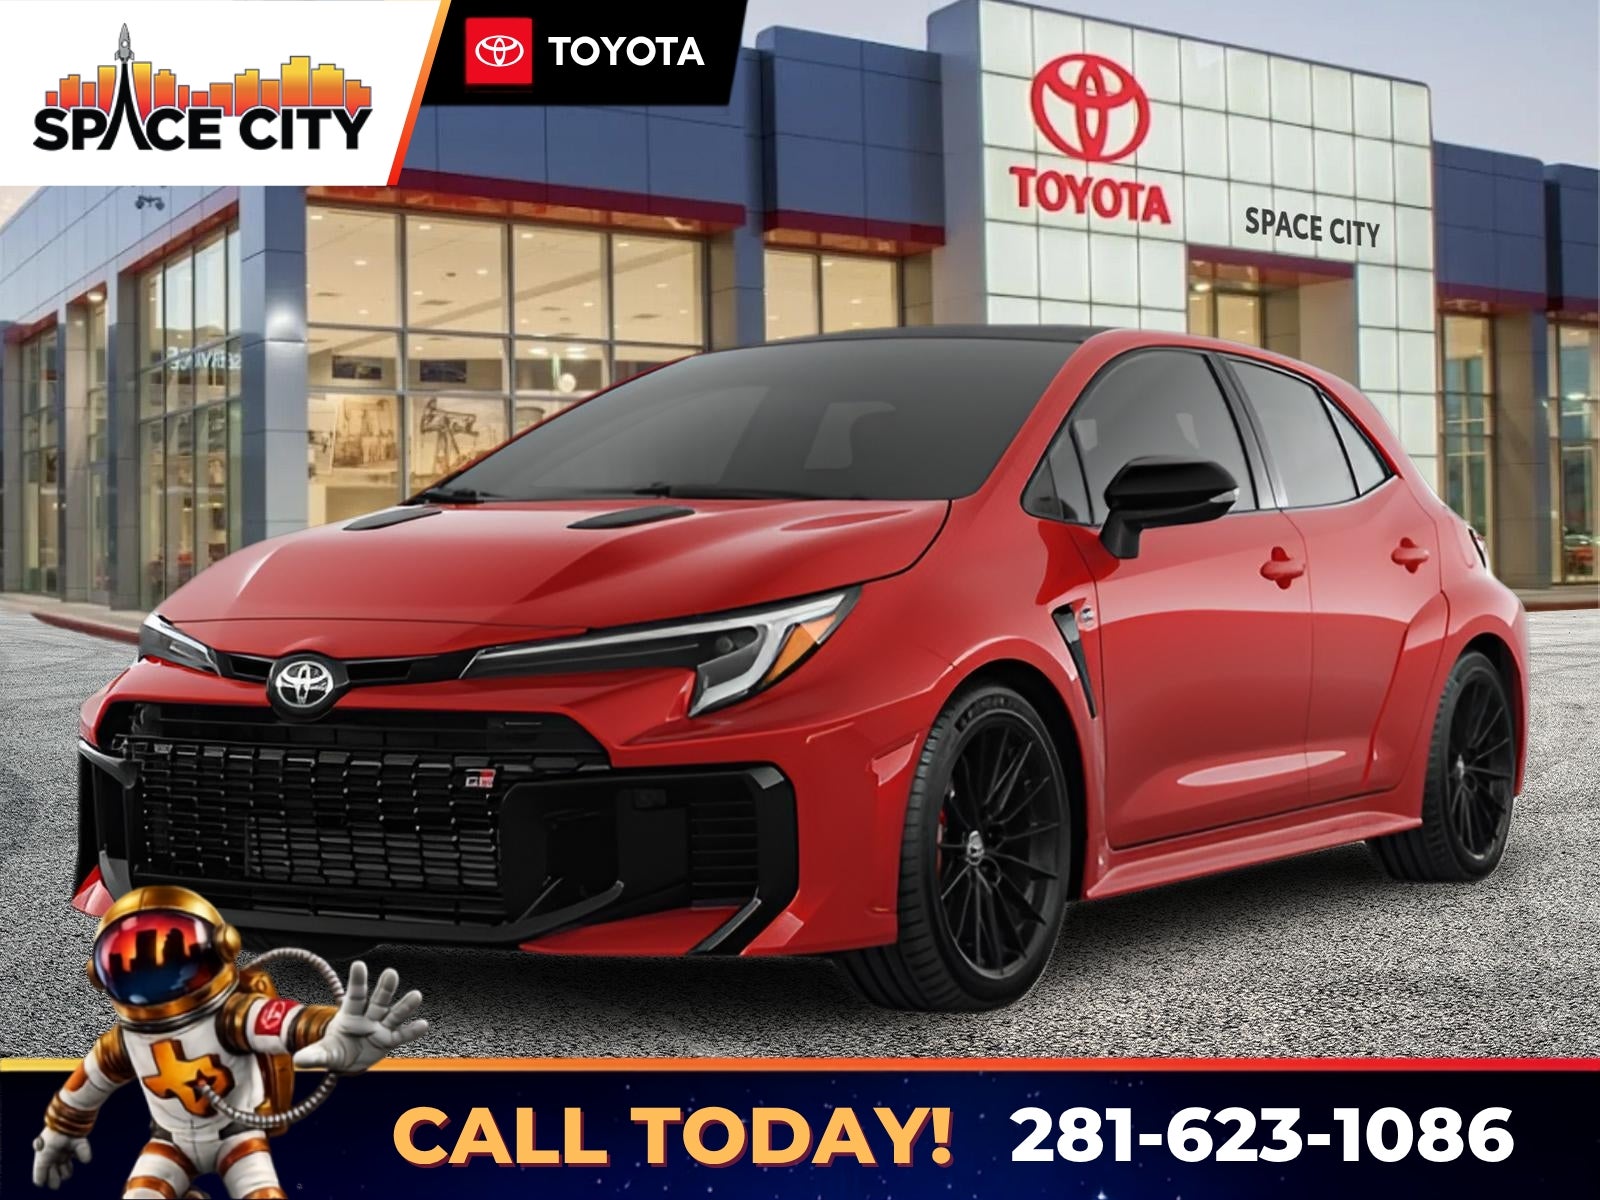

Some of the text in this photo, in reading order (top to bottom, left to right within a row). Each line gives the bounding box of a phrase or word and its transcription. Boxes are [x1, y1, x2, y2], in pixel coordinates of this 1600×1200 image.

[1009, 166, 1171, 224] TOYOTA
[1245, 206, 1381, 248] SPACE CITY
